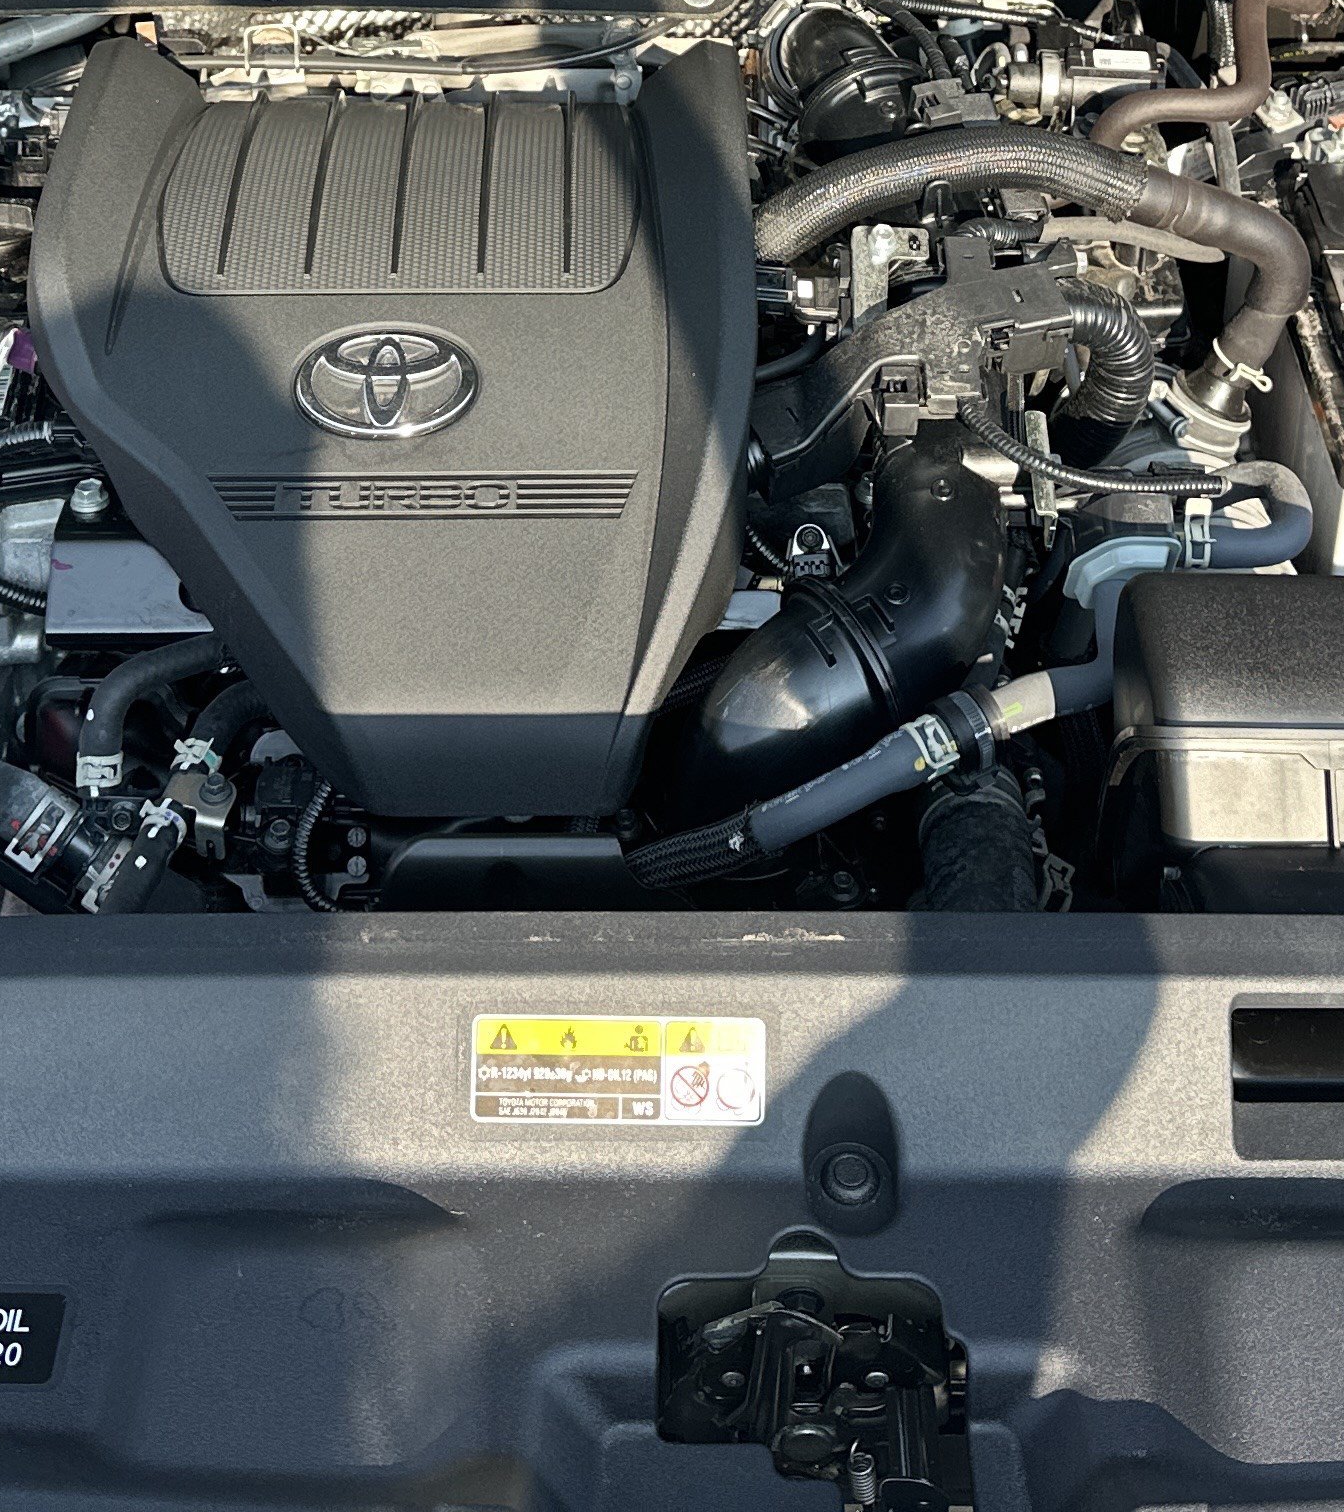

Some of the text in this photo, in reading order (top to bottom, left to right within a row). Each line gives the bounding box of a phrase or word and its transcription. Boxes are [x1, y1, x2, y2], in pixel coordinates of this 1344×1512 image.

[282, 480, 511, 510] TURBO
[498, 1097, 524, 1107] TOYOTA
[631, 1101, 655, 1117] WS
